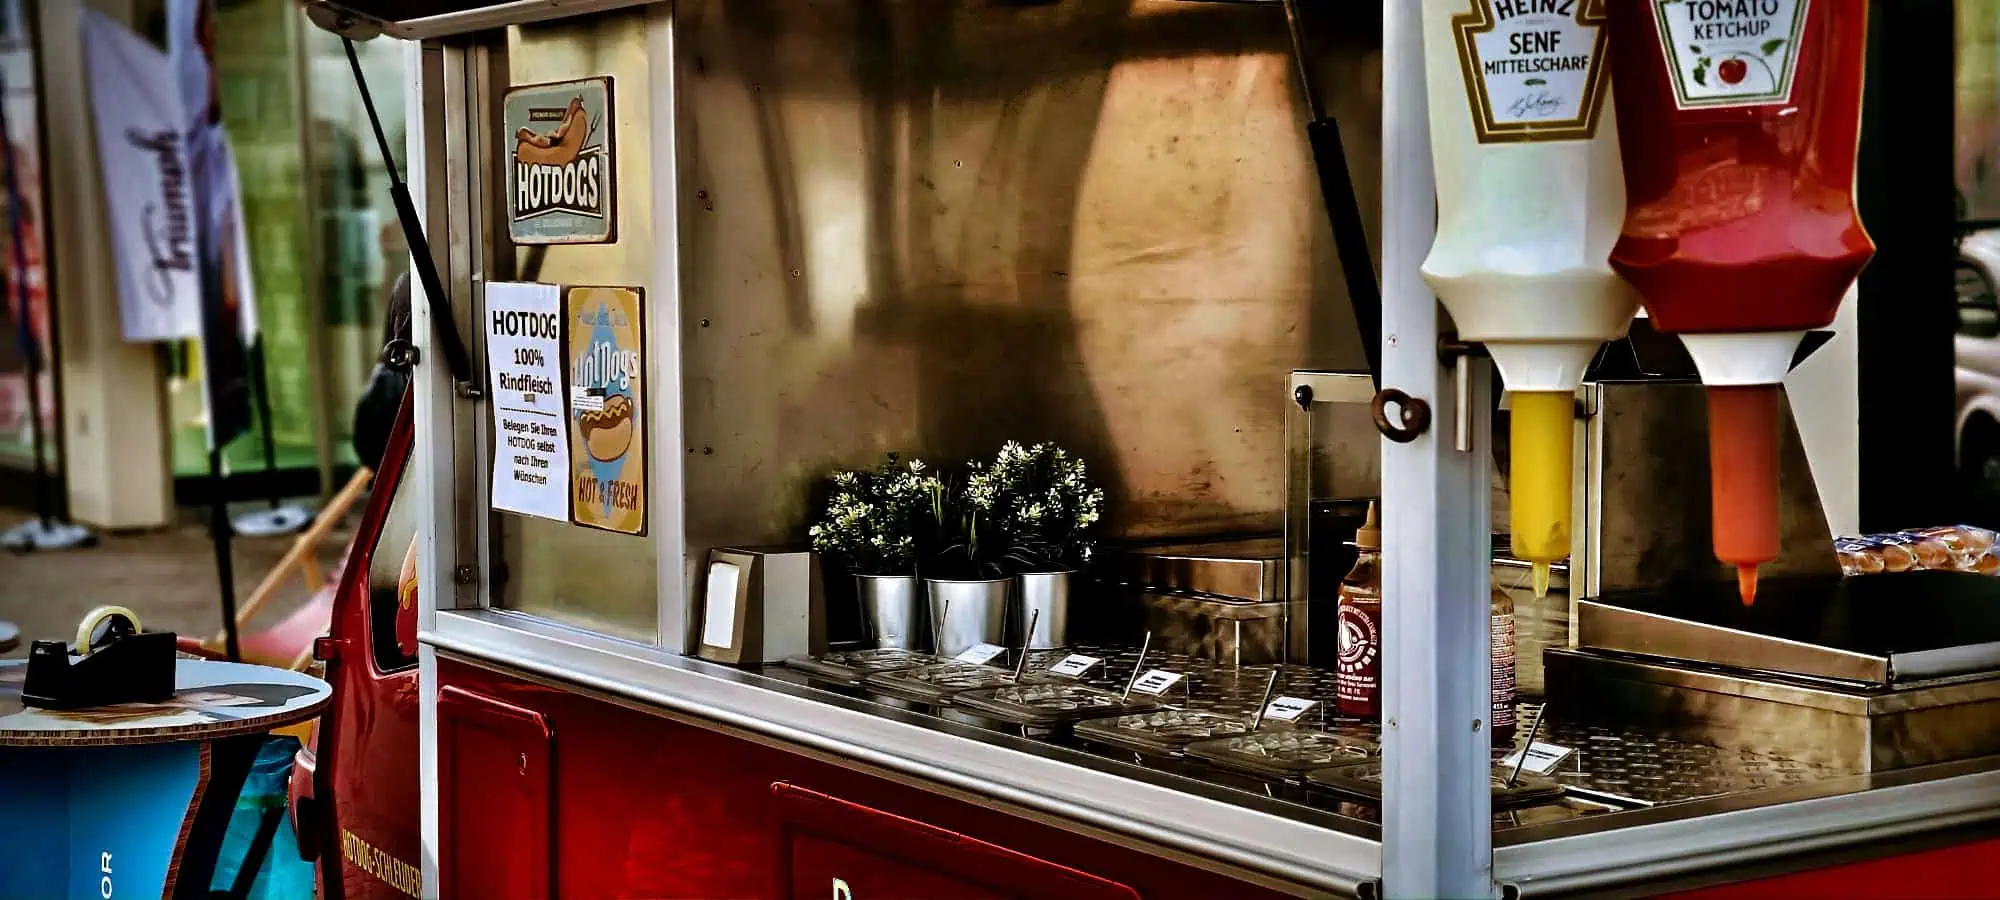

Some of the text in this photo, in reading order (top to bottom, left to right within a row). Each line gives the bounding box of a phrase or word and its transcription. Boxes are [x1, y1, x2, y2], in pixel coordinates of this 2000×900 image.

[1687, 0, 1779, 21] TOMATO
[1694, 20, 1770, 40] KETCHUP
[1509, 31, 1562, 55] SENF
[1484, 55, 1589, 75] MITTELSCHARF
[517, 156, 599, 212] HOTDOGS
[124, 128, 190, 307] Triumph
[492, 310, 557, 340] HOTDOG
[514, 347, 545, 368] 100%
[499, 372, 553, 395] Rindfleisch
[503, 418, 558, 437] Belegen Sie Ihren
[507, 436, 556, 454] HOTDOG selbst
[513, 455, 549, 469] nach Ihren
[513, 470, 547, 486] Wünschen
[578, 476, 598, 504] HOT
[607, 480, 638, 511] FRESH
